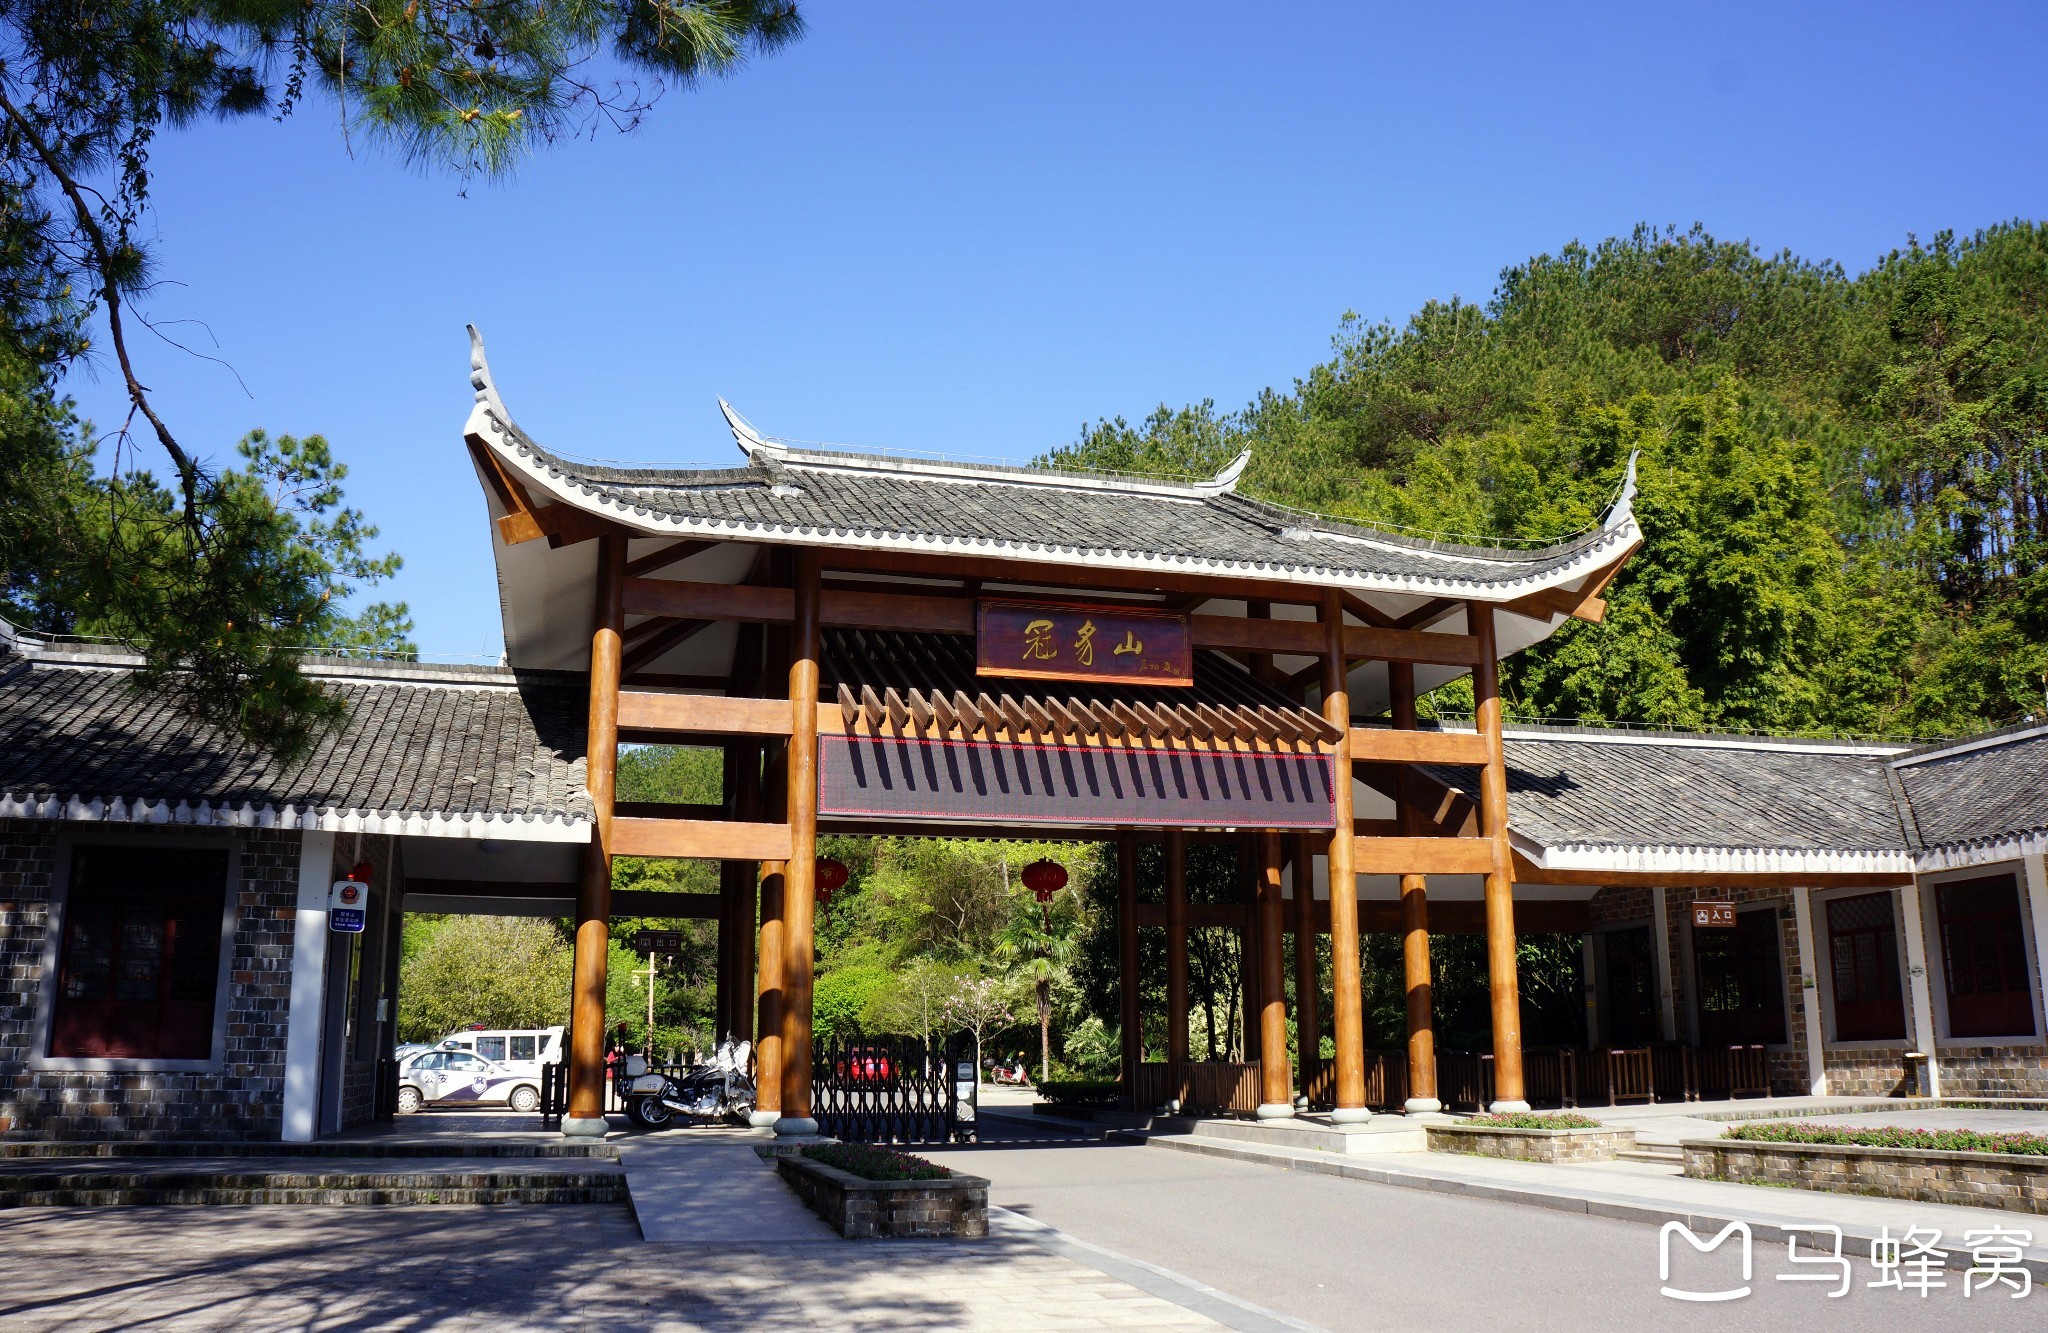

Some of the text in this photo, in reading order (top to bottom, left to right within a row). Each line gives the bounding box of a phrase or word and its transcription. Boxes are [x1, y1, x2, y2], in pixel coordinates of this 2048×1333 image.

[1712, 910, 1732, 920] 入口
[656, 938, 677, 947] 出口
[424, 1074, 449, 1084] 公安
